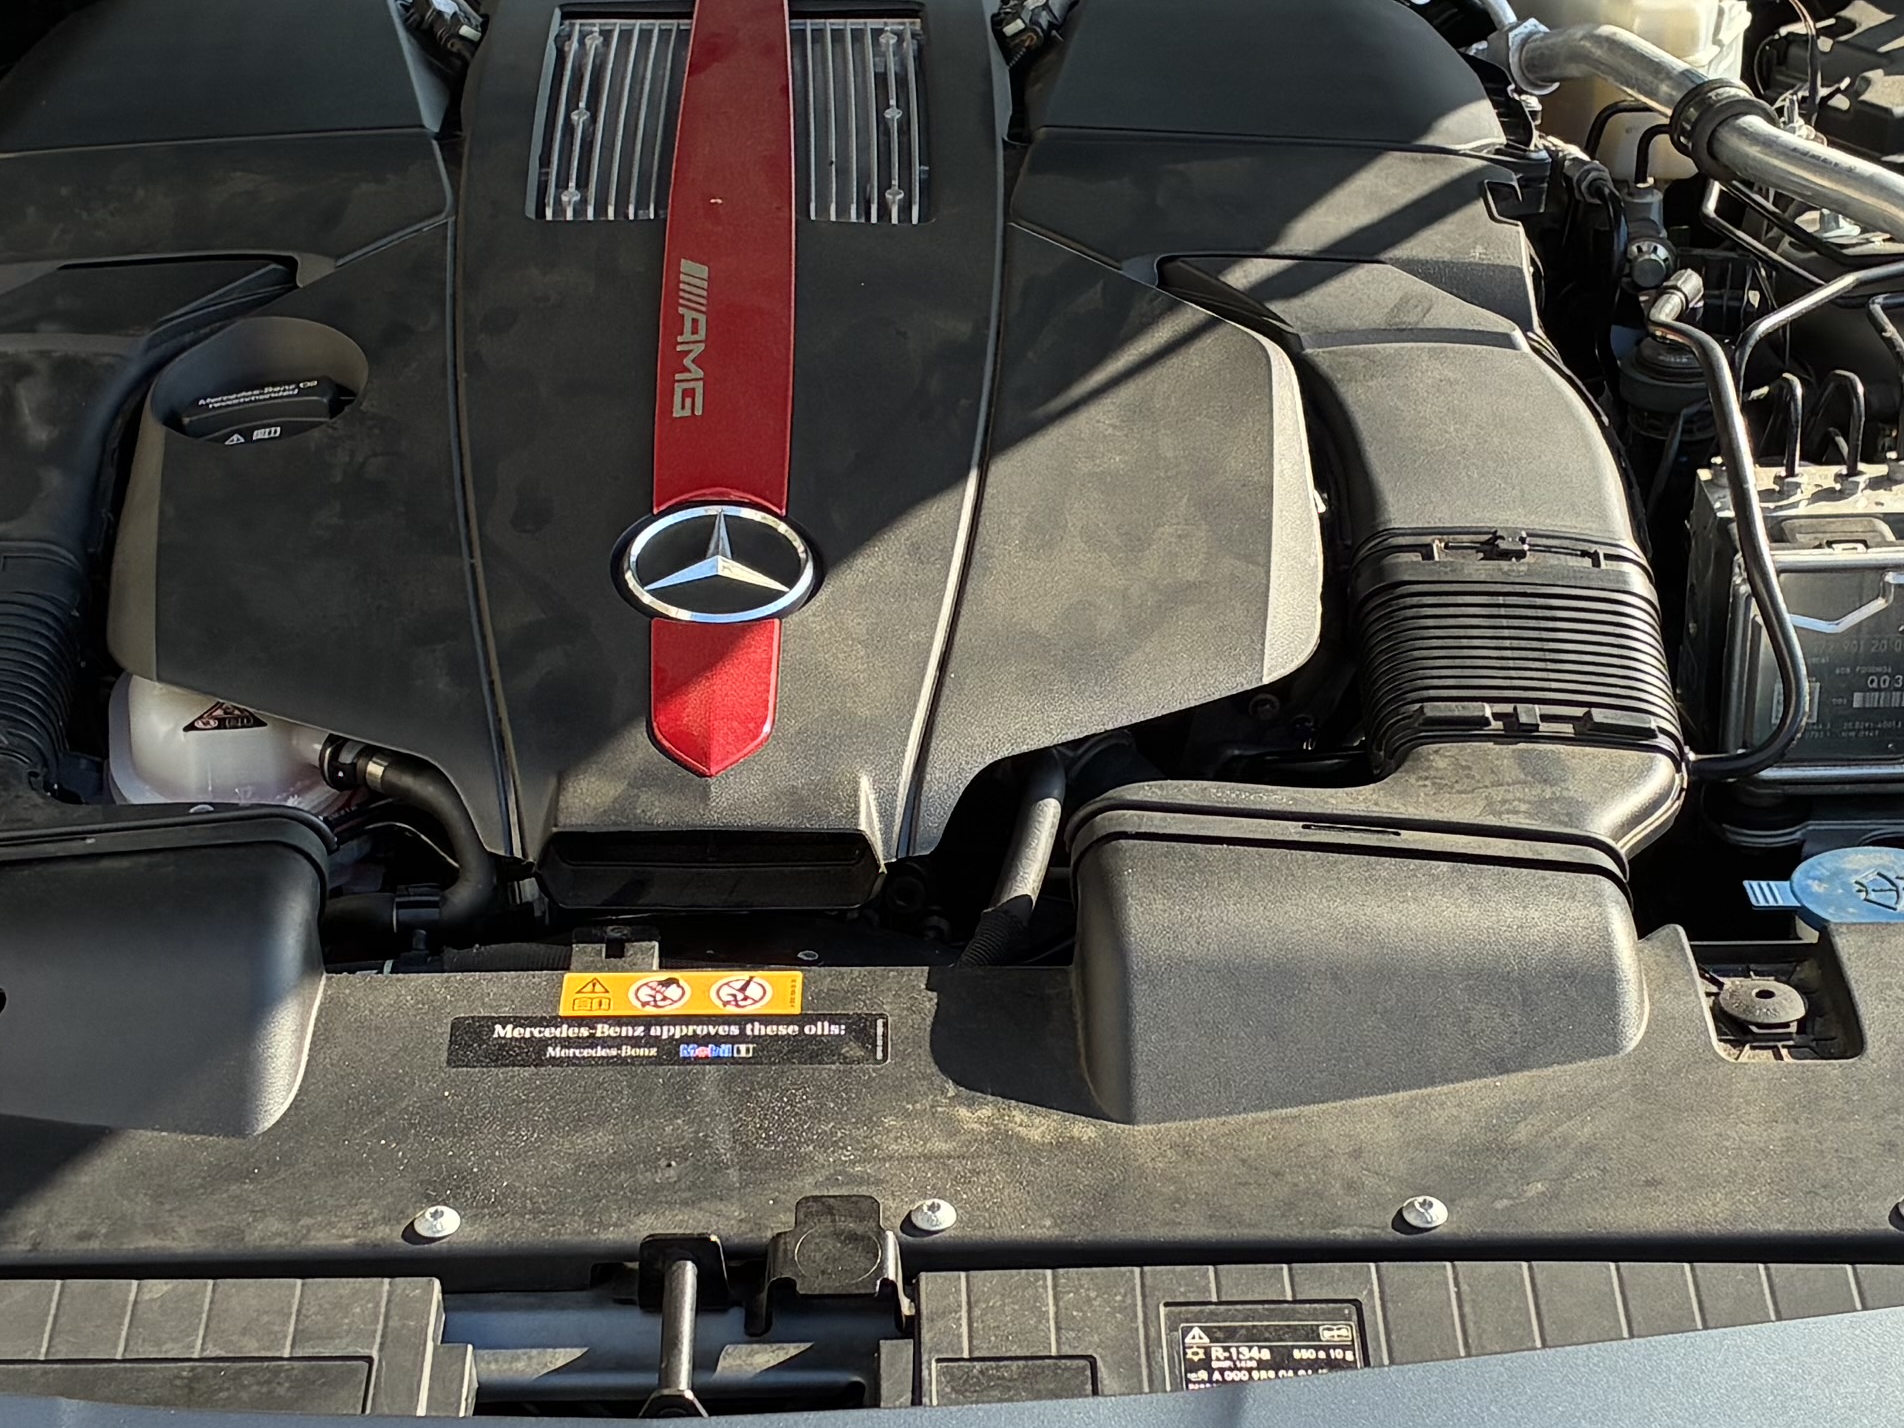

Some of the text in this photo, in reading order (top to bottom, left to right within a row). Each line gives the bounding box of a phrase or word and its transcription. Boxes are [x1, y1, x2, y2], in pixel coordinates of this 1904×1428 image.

[672, 306, 707, 418] AMG
[493, 1021, 846, 1039] Mercedes-Benz approves these oils:
[546, 1045, 658, 1059] Mercedes-Benz
[680, 1044, 732, 1058] Mobil
[1211, 1346, 1271, 1361] R-134a
[1224, 1370, 1249, 1382] 000
